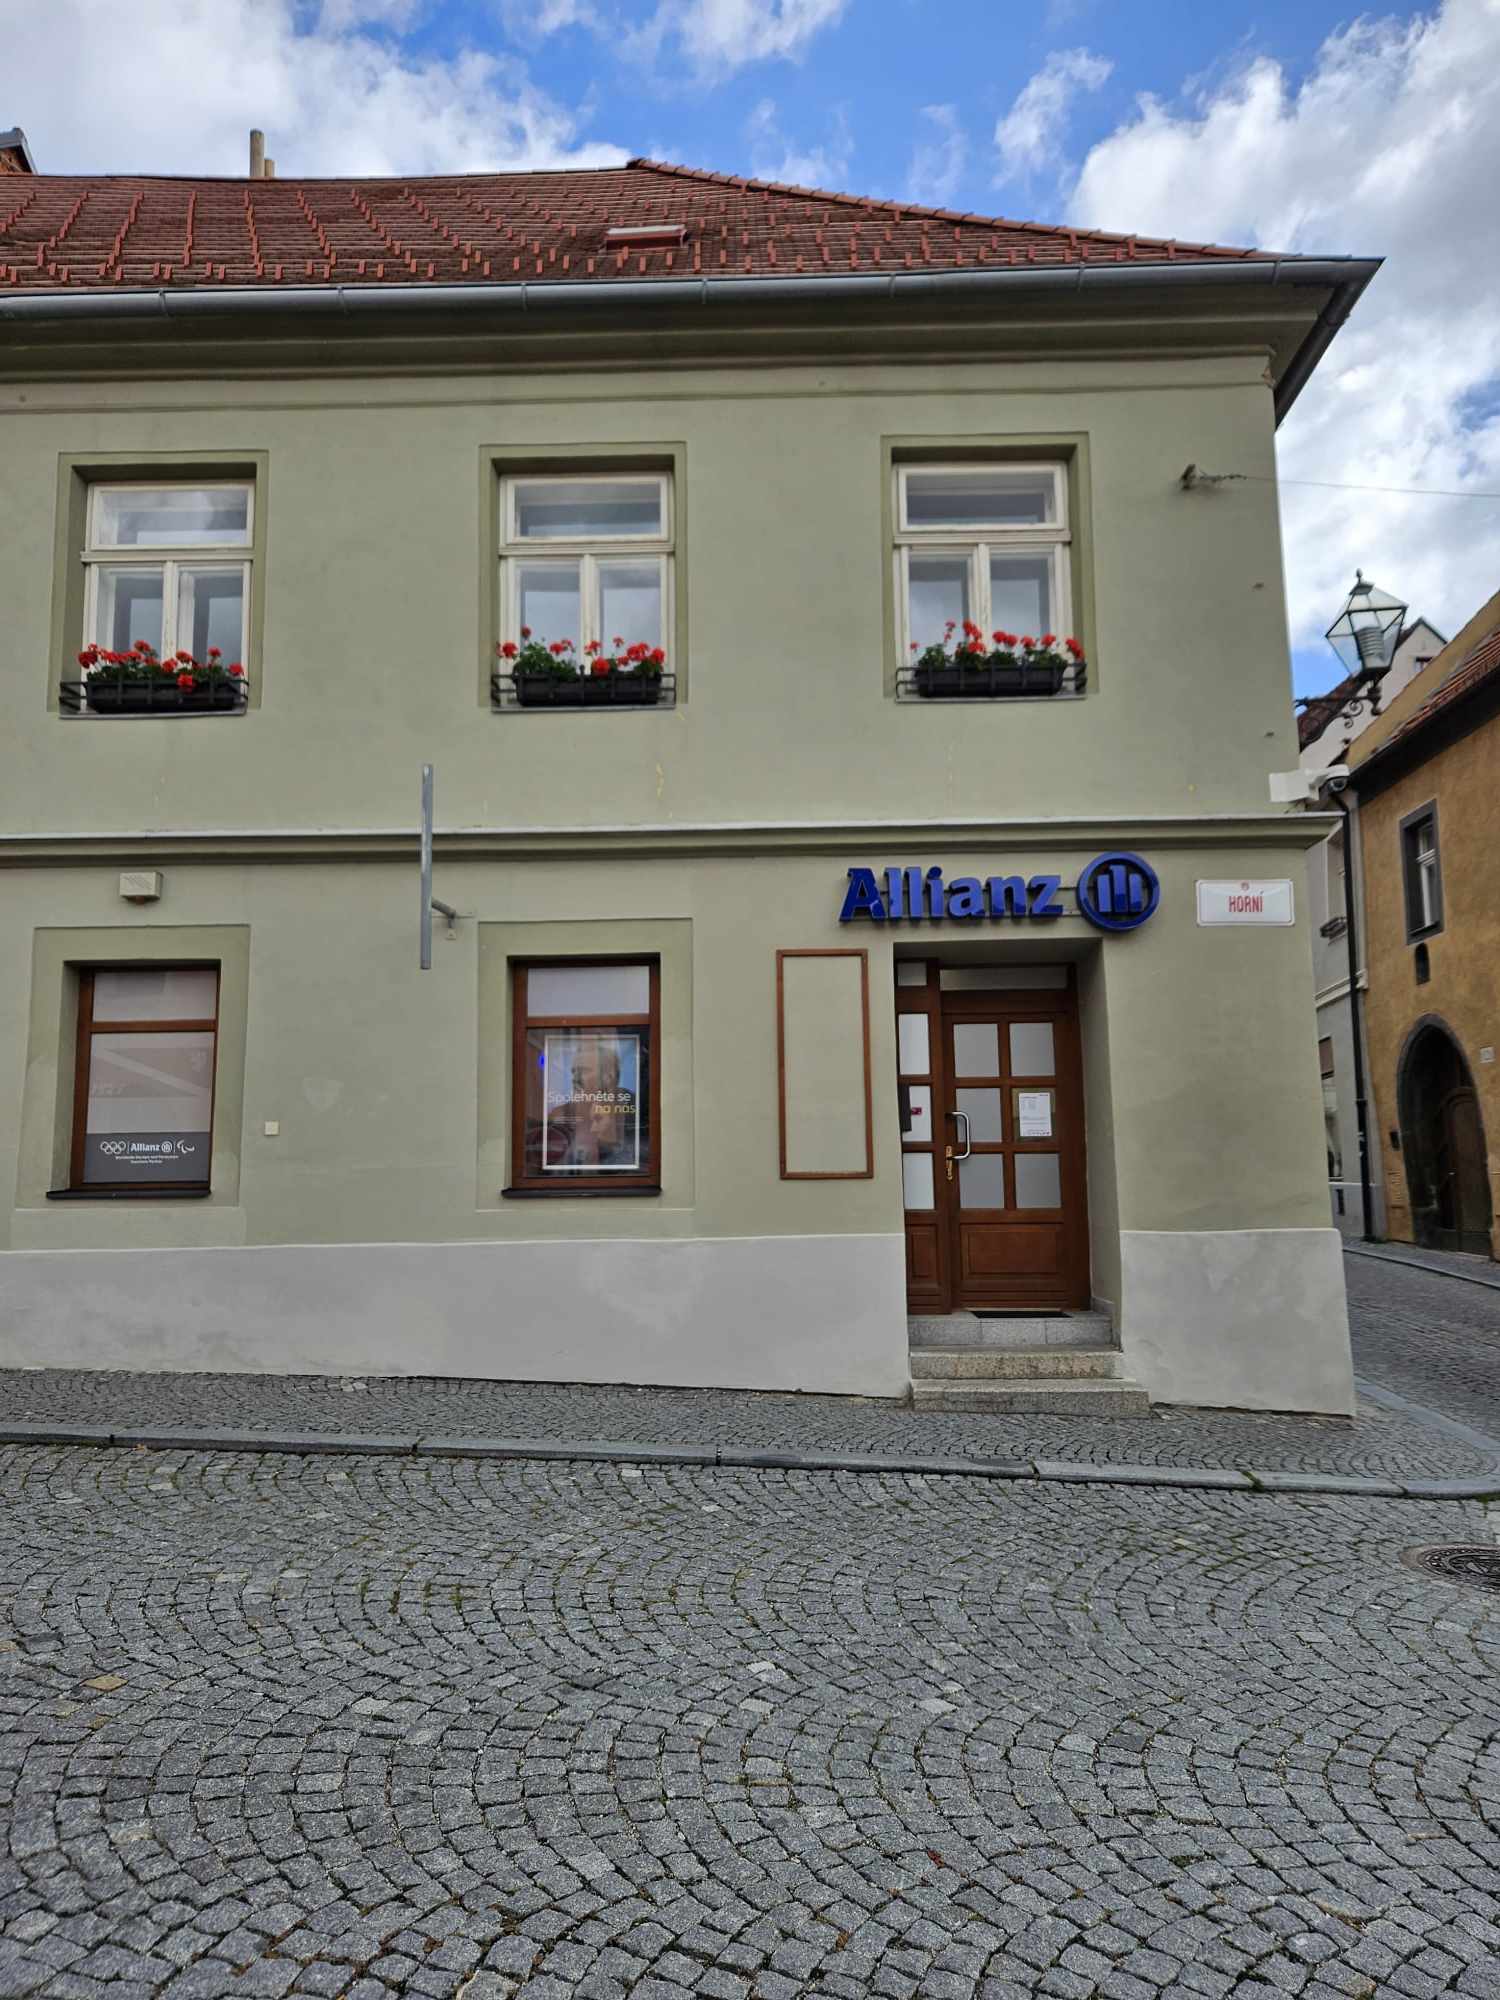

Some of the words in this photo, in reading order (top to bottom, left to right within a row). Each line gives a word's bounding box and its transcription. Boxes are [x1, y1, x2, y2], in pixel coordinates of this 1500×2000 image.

[839, 866, 1063, 922] Allianz
[1228, 890, 1264, 913] HORNÍ
[617, 1092, 631, 1101] se
[130, 1142, 160, 1152] Allianz
